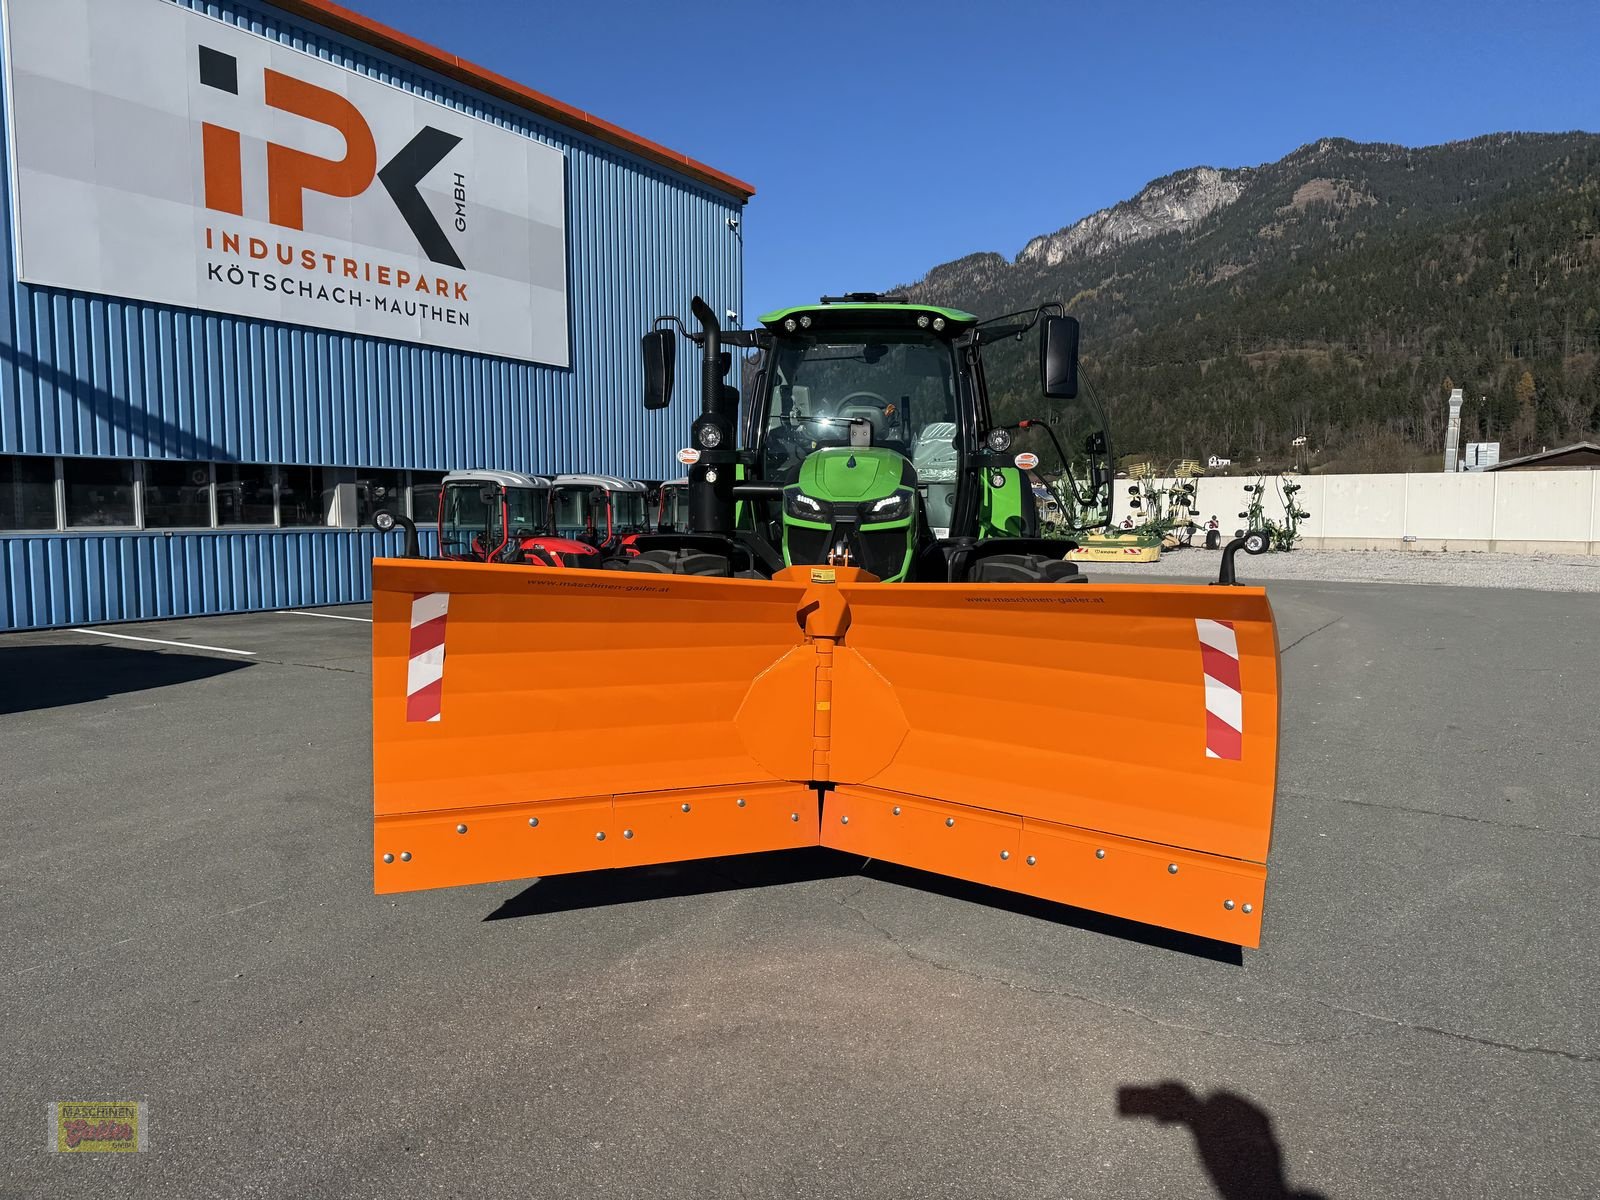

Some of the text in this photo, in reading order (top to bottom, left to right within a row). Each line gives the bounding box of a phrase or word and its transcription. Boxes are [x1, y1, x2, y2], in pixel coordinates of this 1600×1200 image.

[453, 173, 467, 233] GMBH
[206, 227, 468, 301] INDUSTRIEPARK
[208, 262, 470, 327] KÖTSCHACH-MAUTHEN
[527, 580, 670, 593] www.maschinen-gailer.at
